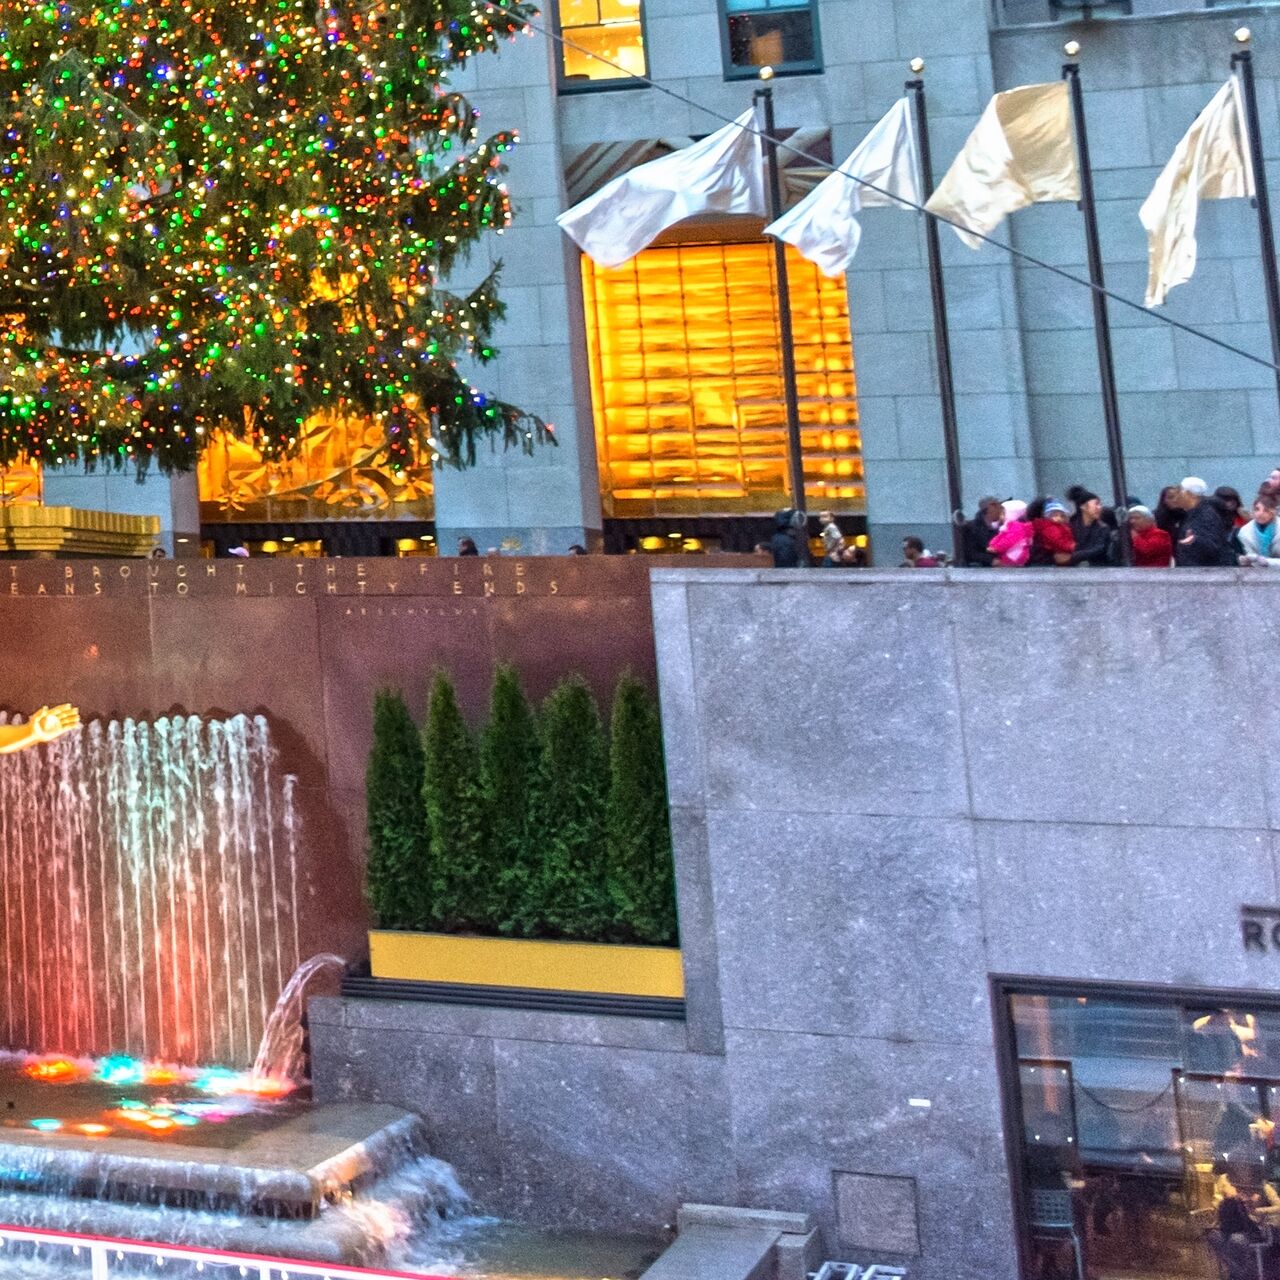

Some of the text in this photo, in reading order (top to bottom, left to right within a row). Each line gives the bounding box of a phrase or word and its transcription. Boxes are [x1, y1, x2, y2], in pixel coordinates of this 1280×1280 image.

[65, 564, 245, 578] BROUGHT
[295, 563, 367, 577] THE
[419, 562, 526, 576] FIRE
[149, 581, 189, 595] TO
[235, 581, 399, 595] MIGHTY
[452, 581, 559, 595] ENDS
